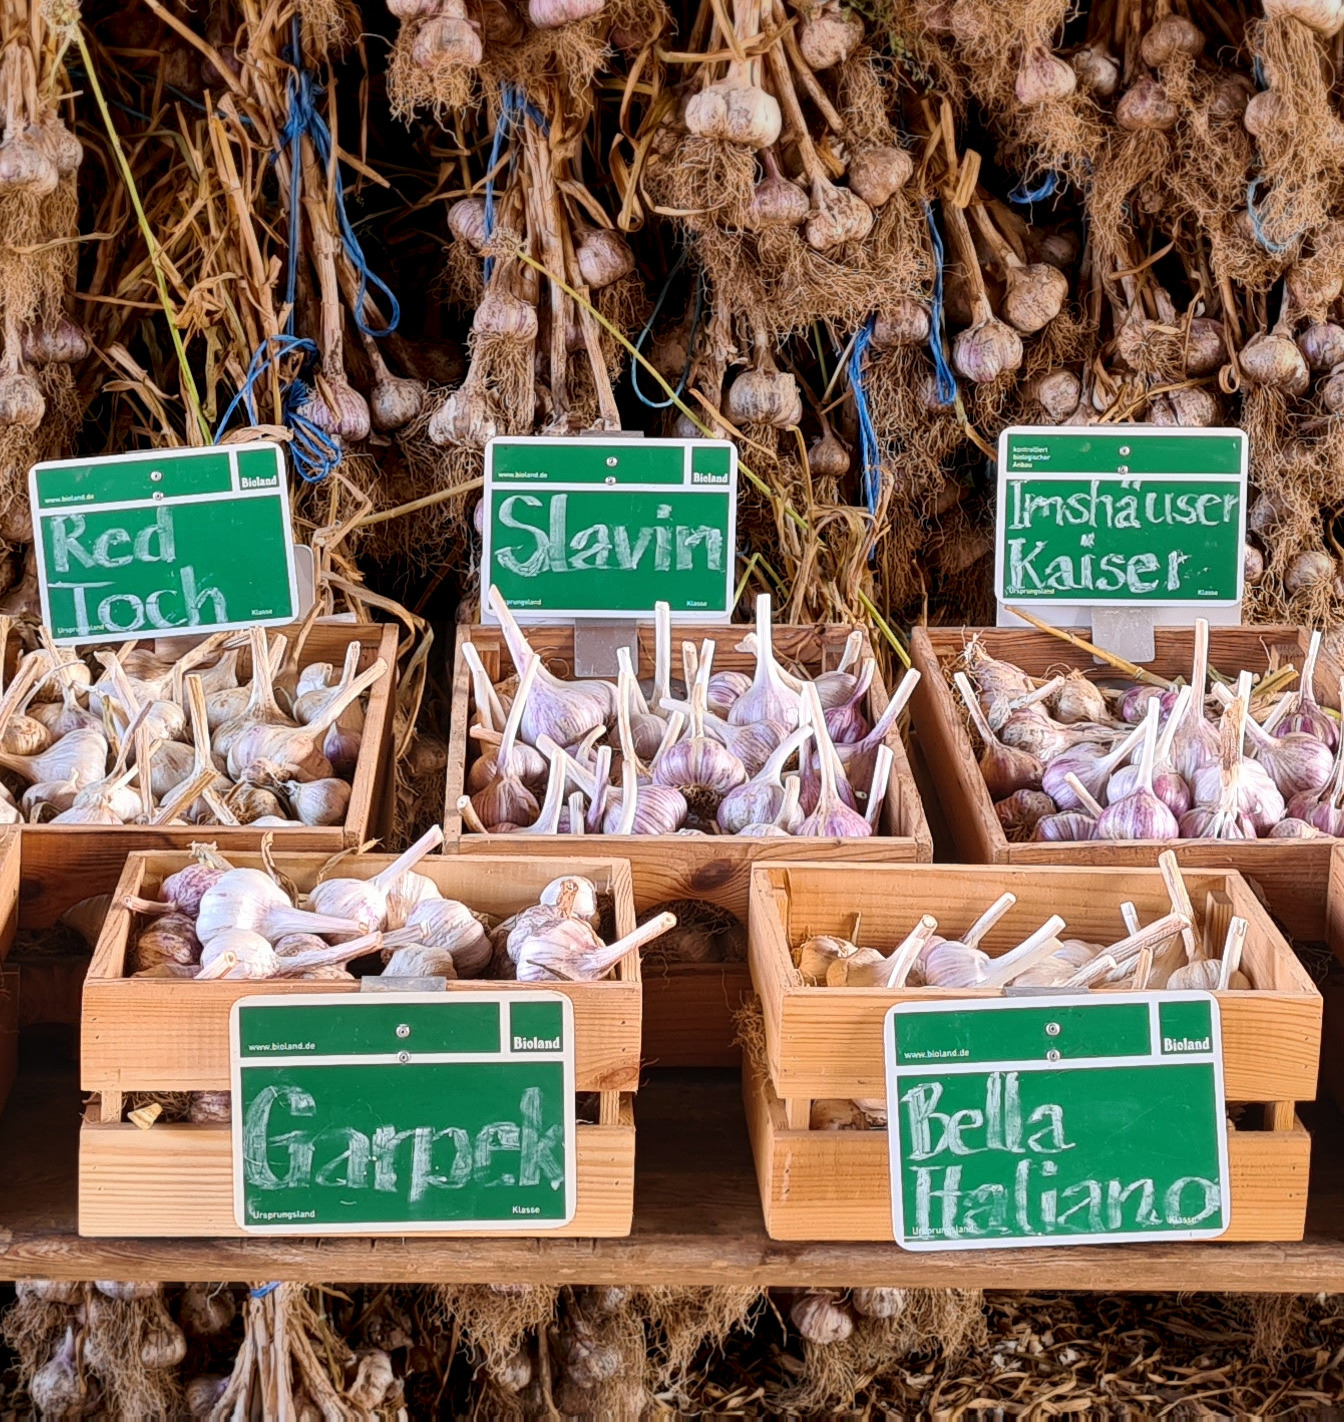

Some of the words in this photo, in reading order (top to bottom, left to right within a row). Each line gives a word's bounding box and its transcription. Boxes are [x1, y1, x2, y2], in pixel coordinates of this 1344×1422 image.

[241, 476, 277, 488] Bioland
[693, 473, 728, 483] Bioland
[50, 506, 176, 573] Red
[494, 493, 726, 577] Slavin
[1007, 532, 1192, 593] Kaiser
[48, 565, 228, 636] Toch
[248, 1042, 315, 1051] www.bioland.de
[514, 1037, 560, 1050] Bioland
[1164, 1037, 1210, 1052] Bioland
[904, 1049, 970, 1059] www.bioland.de
[900, 1071, 1076, 1160] Bella
[243, 1085, 564, 1202] Garpek
[909, 1159, 1220, 1239] Italiano
[252, 1210, 315, 1221] Ursprungsland
[513, 1206, 540, 1214] Klasse
